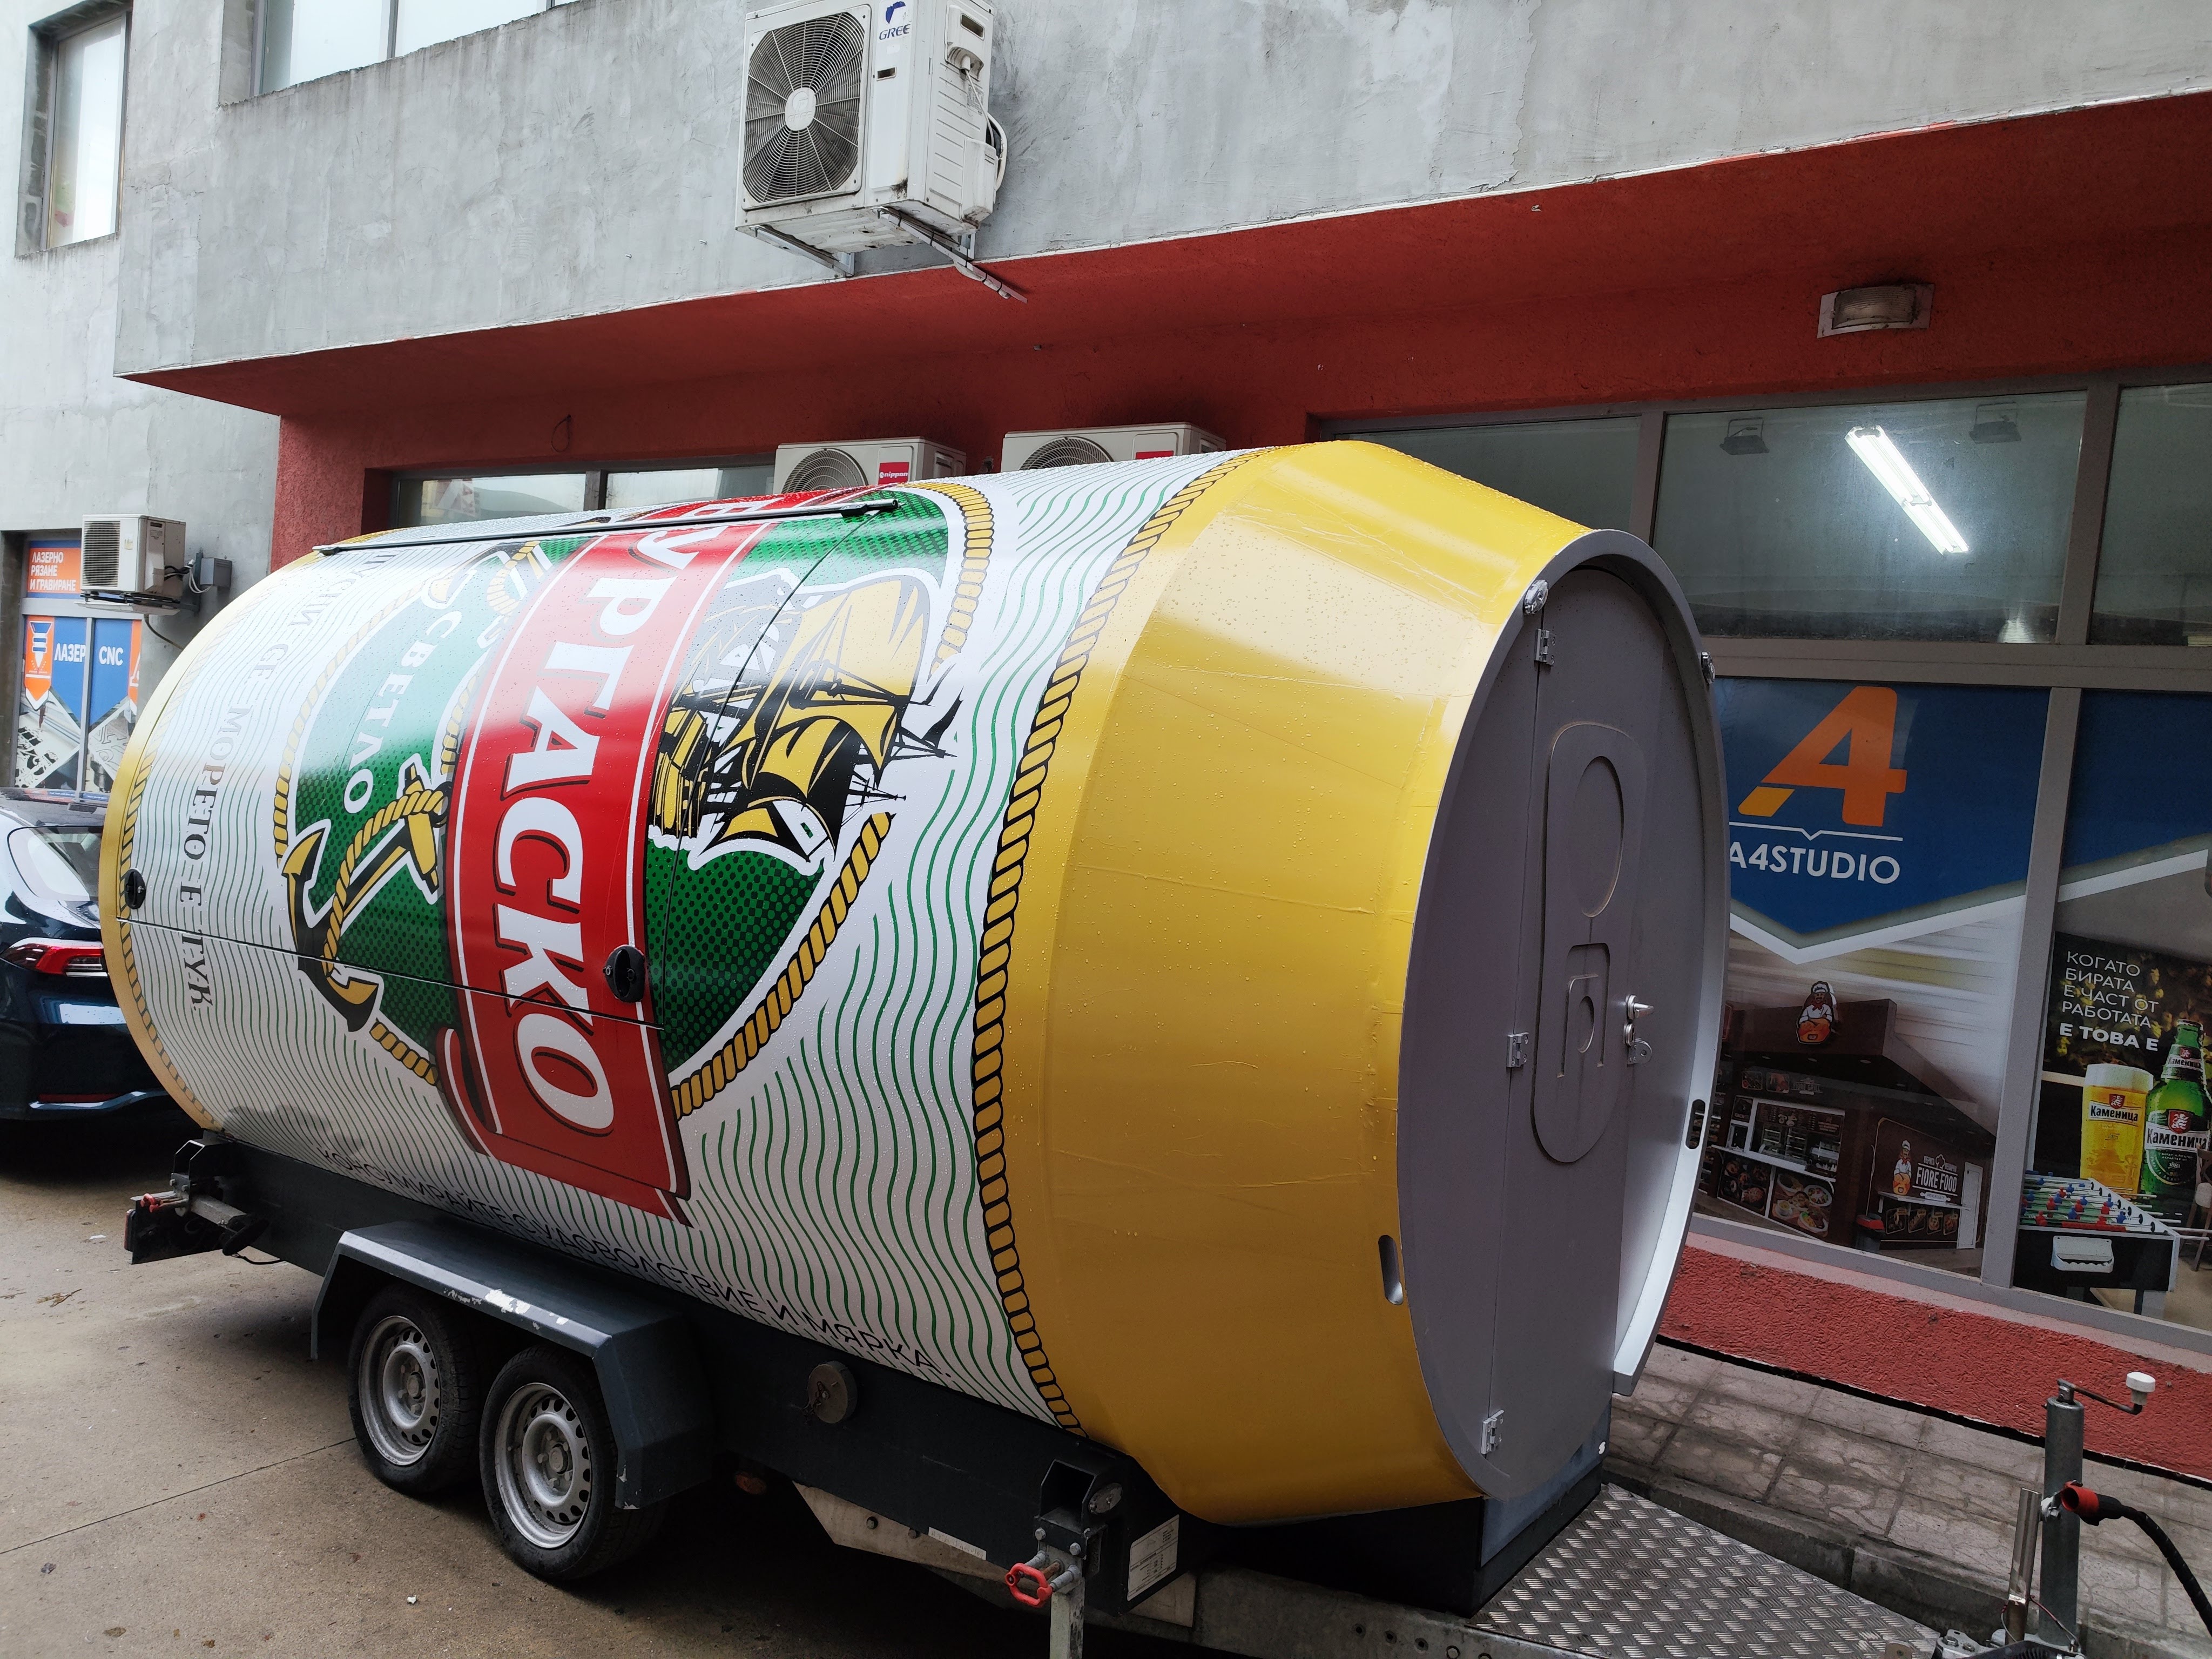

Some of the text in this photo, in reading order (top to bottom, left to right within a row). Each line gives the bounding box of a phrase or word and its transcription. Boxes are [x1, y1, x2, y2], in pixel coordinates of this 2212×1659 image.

[879, 24, 911, 41] GREE
[32, 551, 64, 563] ЛАЗЕРНО
[31, 564, 58, 576] РЯЗАНЕ
[30, 578, 76, 591] И ГРАВИРАНЕ
[54, 643, 86, 663] ЛАЗЕР
[99, 646, 124, 666] CNC
[343, 610, 463, 814] СВЕТЛО
[184, 704, 253, 860] МОРЕТО
[1730, 841, 1900, 884] A4STUDIO
[180, 881, 202, 906] Е
[2067, 951, 2140, 976] КОГАТО
[2065, 967, 2135, 993] БИРАТА
[2063, 984, 2159, 1013] Е ЧАСТ ОТ
[2062, 1001, 2151, 1028] РАБОТАТА
[2059, 1022, 2159, 1051] Е ТОВА Е
[2090, 1105, 2138, 1122] Каменица
[2147, 1128, 2208, 1149] Каменица
[1916, 1166, 1939, 1188] FIORE
[1939, 1171, 1957, 1192] FOOD
[532, 1219, 766, 1315] УДОВОЛСТВИЕ
[766, 1299, 799, 1326] И
[801, 1311, 952, 1378] МЯРКА.
